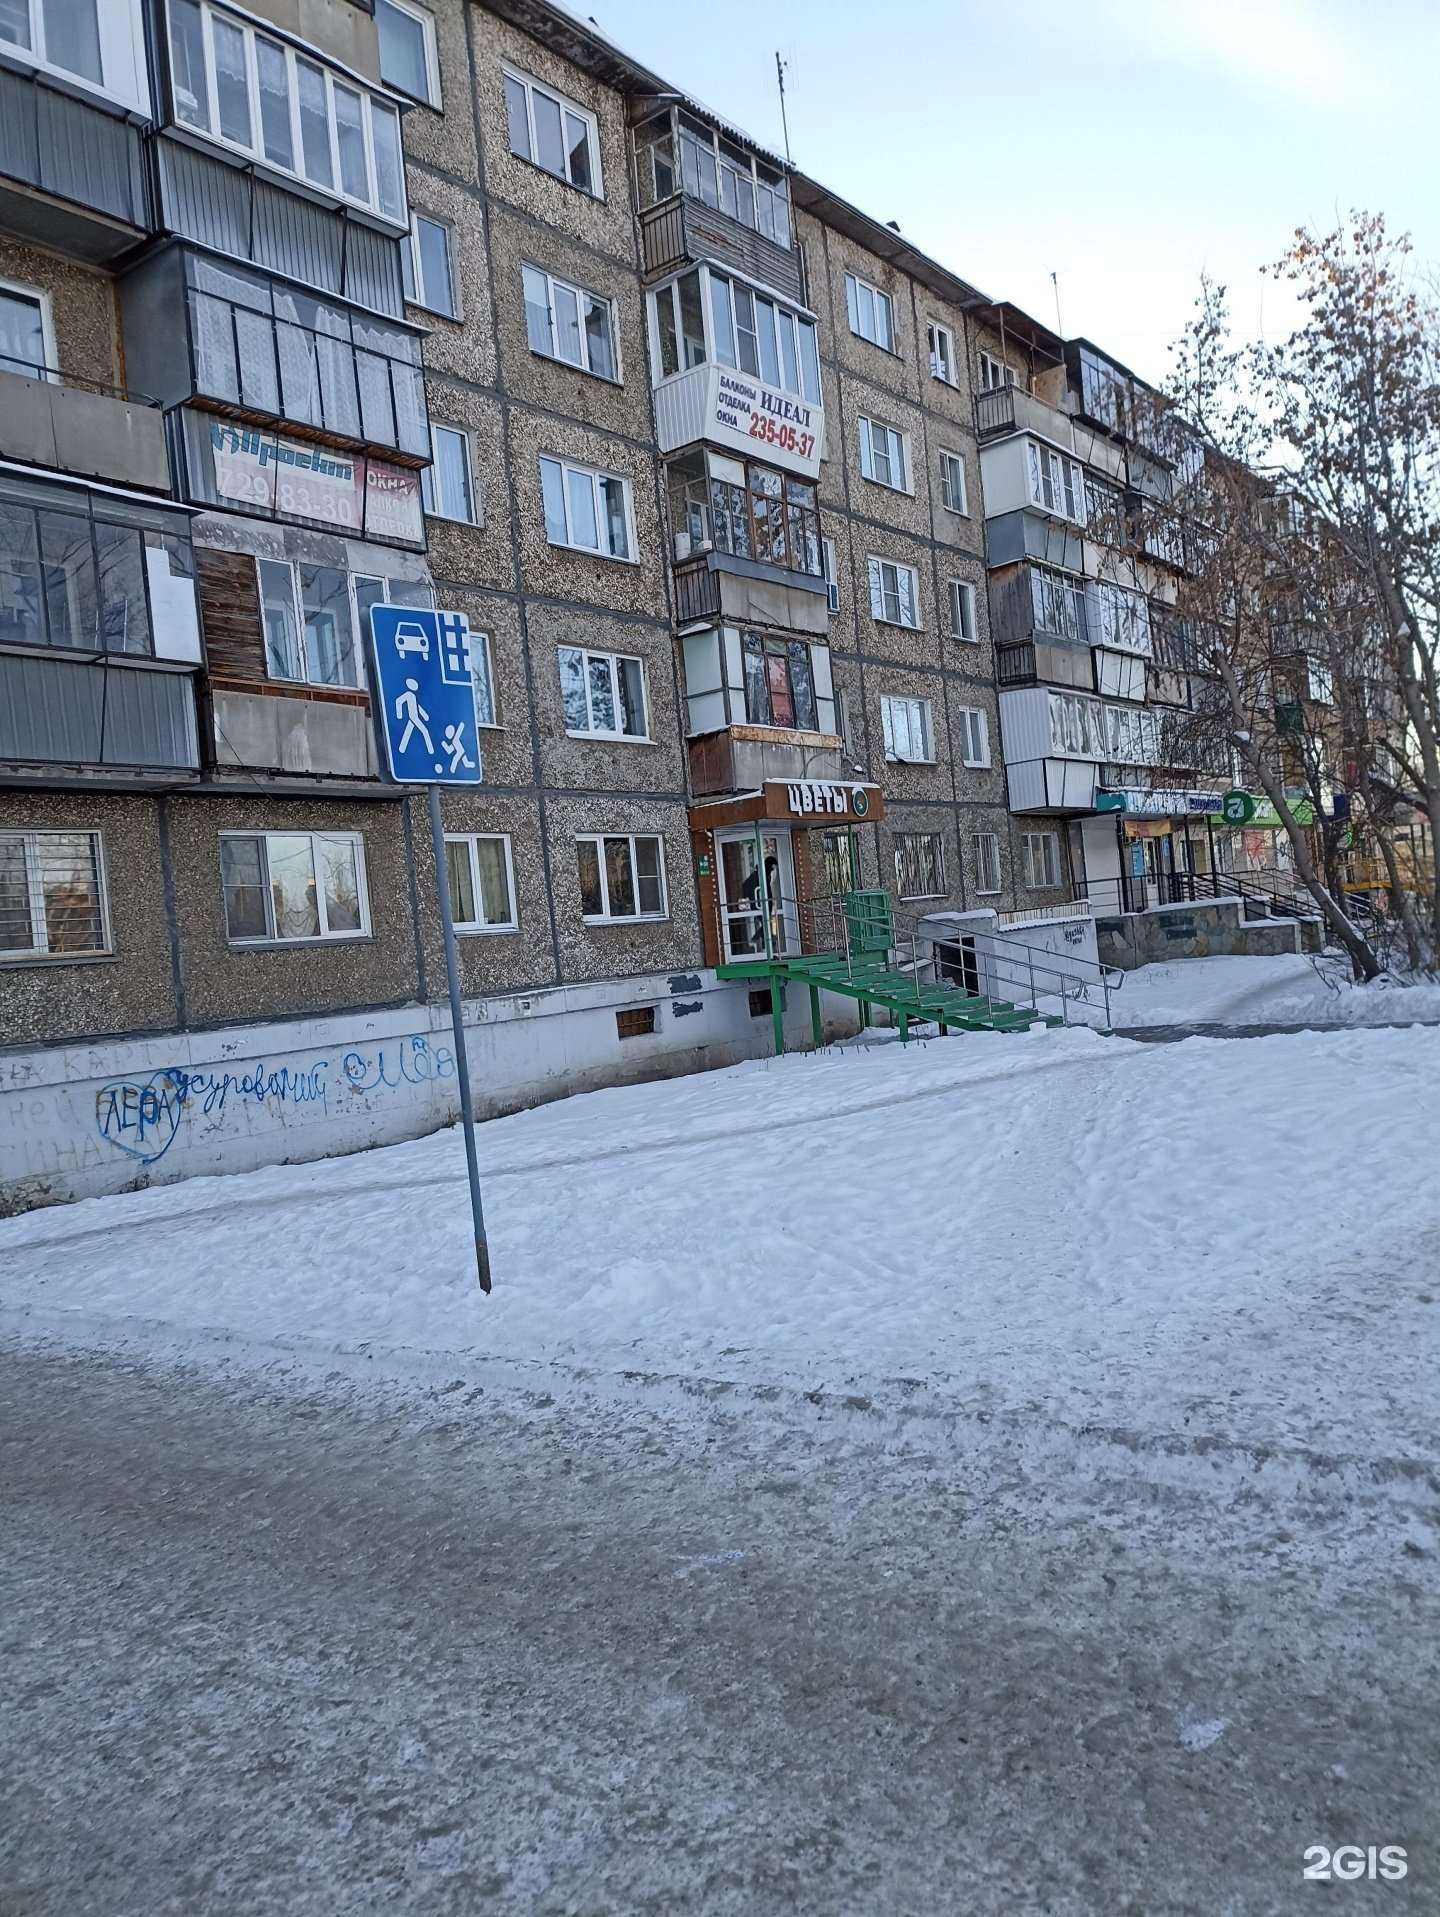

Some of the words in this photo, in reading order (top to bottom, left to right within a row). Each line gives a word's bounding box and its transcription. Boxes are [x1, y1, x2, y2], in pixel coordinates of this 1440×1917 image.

[718, 391, 751, 415] ОТДЕЛКА
[719, 375, 757, 401] БАЛКОНЫ
[760, 391, 811, 428] ИДЕАЛ
[716, 409, 738, 427] ОКНА
[748, 411, 815, 458] 235-05-37
[367, 470, 409, 496] ОКНА
[787, 784, 848, 817] ЦВЕТЫ
